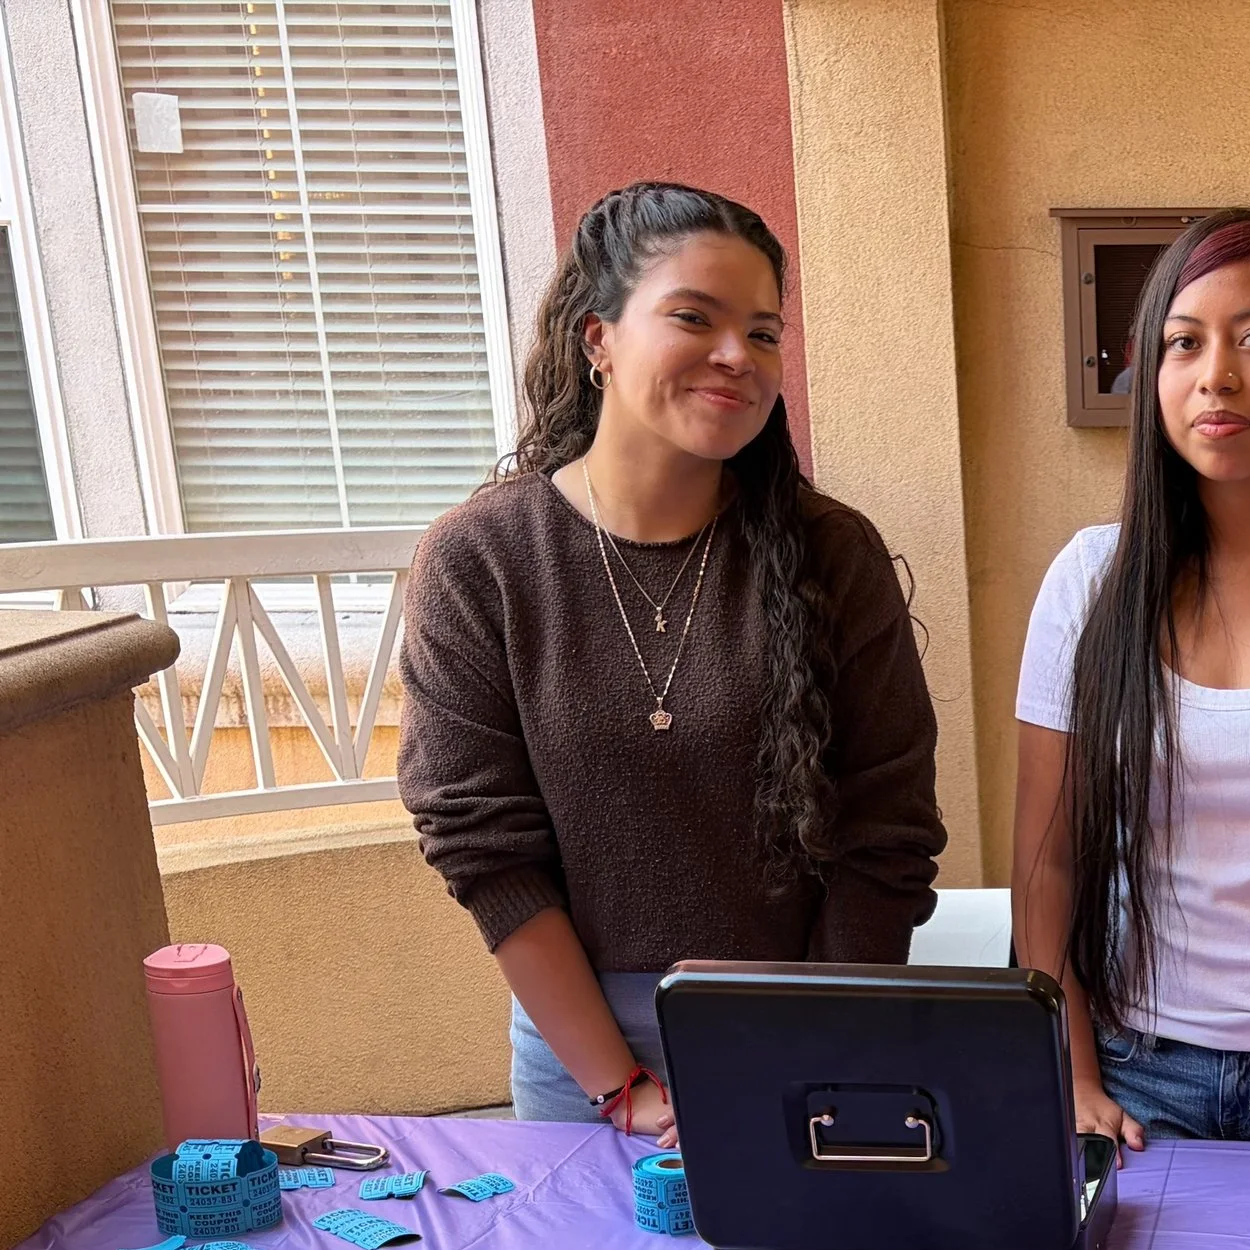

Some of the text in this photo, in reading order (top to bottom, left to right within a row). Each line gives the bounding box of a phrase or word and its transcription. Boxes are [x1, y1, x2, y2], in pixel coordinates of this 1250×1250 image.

[185, 1182, 238, 1196] TICKET
[189, 1210, 241, 1221] KEEP THIS
[194, 1217, 238, 1227] COUPON
